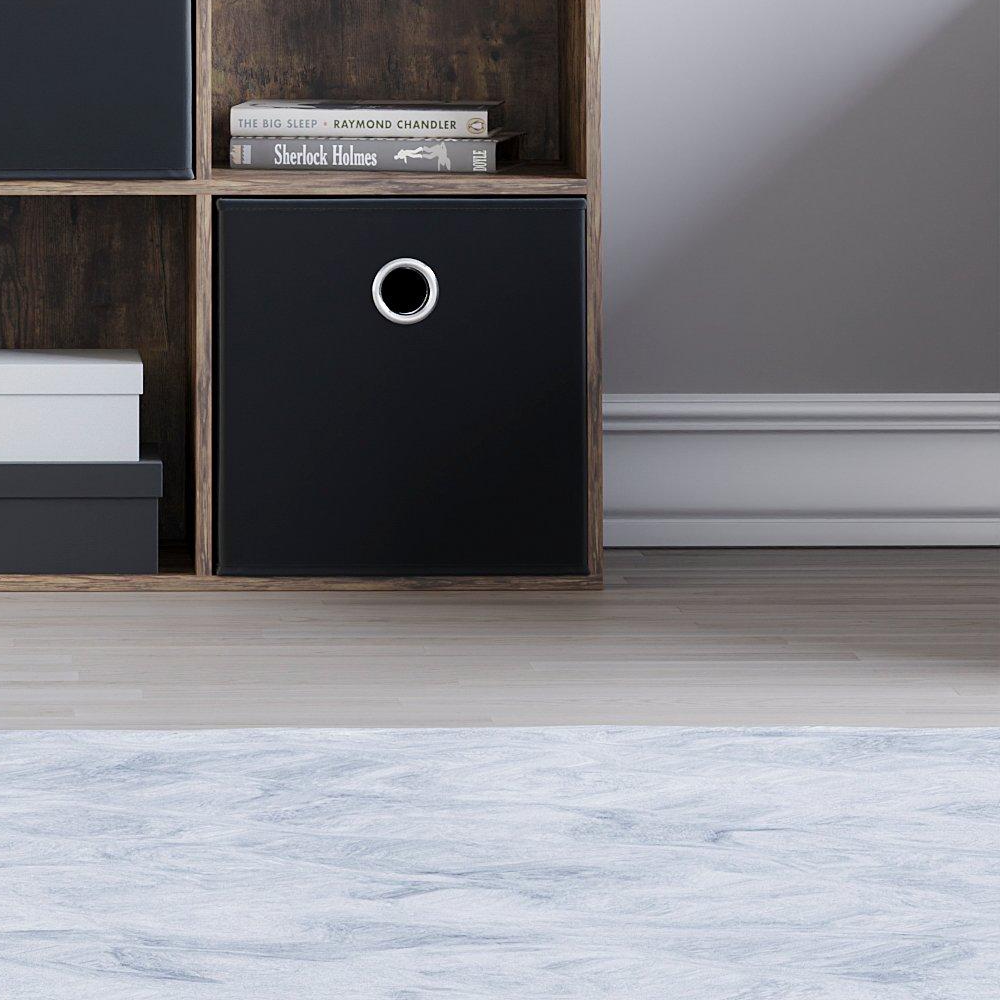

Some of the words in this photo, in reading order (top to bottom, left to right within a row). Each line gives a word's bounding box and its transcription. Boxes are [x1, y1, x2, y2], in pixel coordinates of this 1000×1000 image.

[238, 118, 258, 128] THE
[262, 118, 282, 128] BIG
[286, 118, 318, 129] SLEEP
[333, 119, 392, 129] RAYMOND
[396, 119, 457, 130] CHANDLER
[274, 143, 328, 166] Sherlock
[332, 144, 378, 167] Holmes
[472, 149, 487, 172] DOYLE
